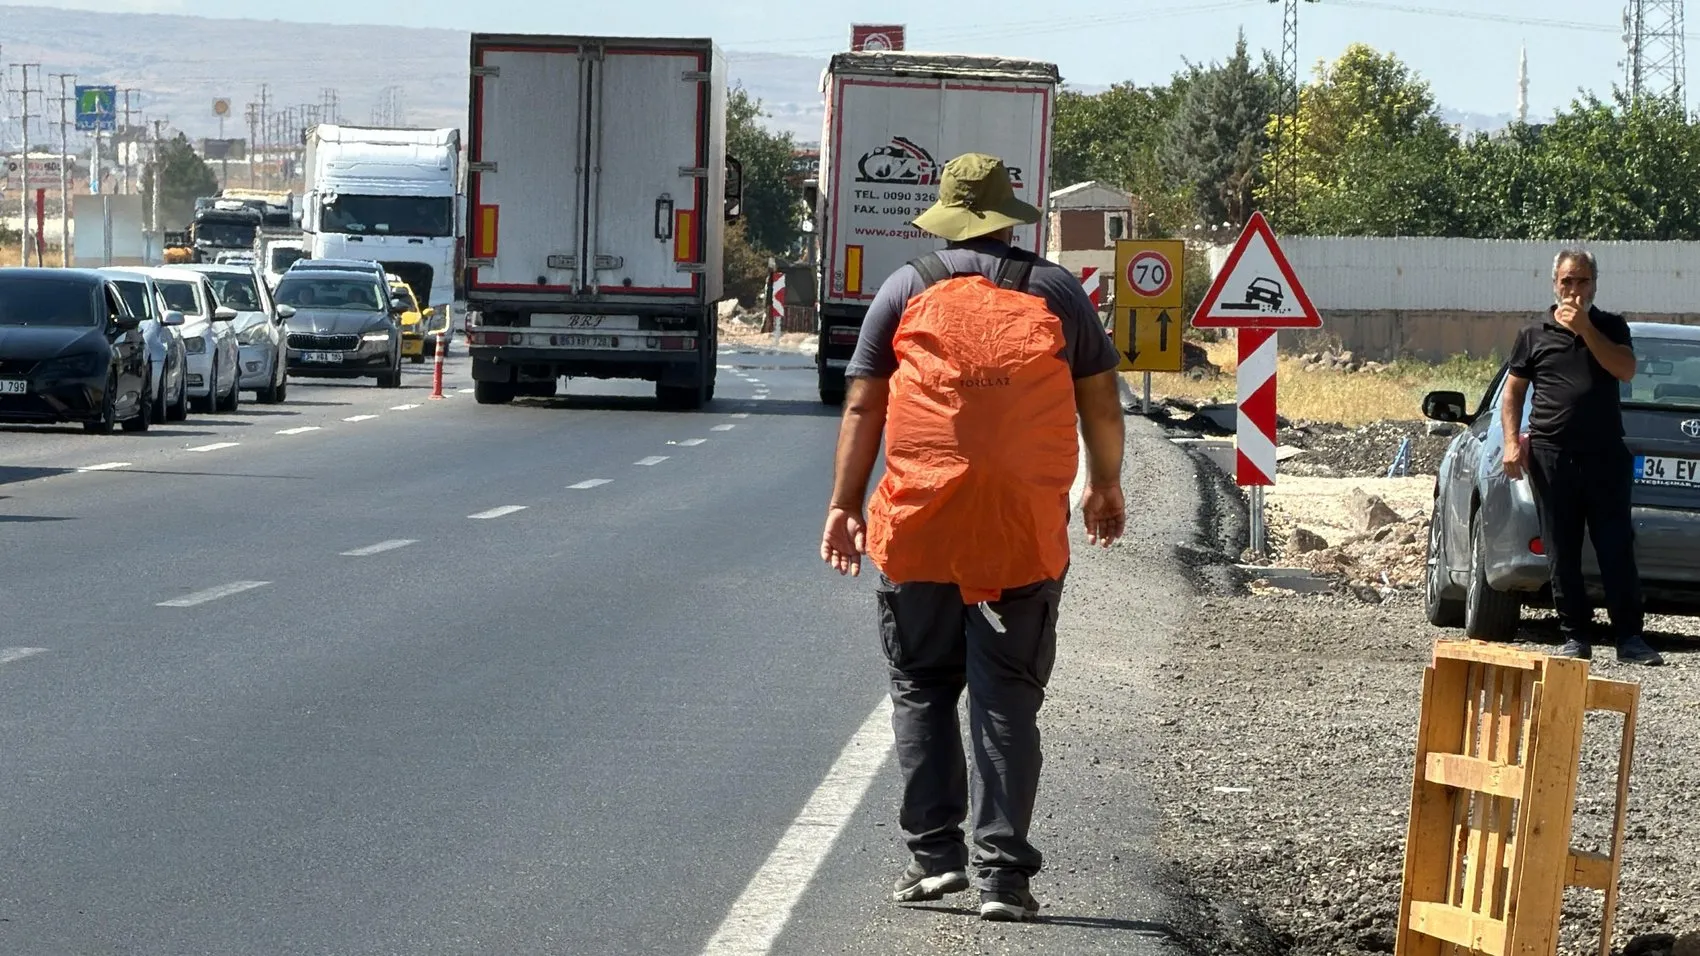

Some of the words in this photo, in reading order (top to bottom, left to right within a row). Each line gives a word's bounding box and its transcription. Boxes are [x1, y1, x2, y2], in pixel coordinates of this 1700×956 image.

[854, 189, 880, 200] TEL.
[884, 191, 911, 202] 0090
[853, 205, 879, 215] FAX.
[882, 207, 911, 216] 0090
[1136, 264, 1165, 285] 70
[8, 381, 25, 393] 799
[1645, 458, 1665, 478] 34
[1676, 460, 1698, 480] EV
